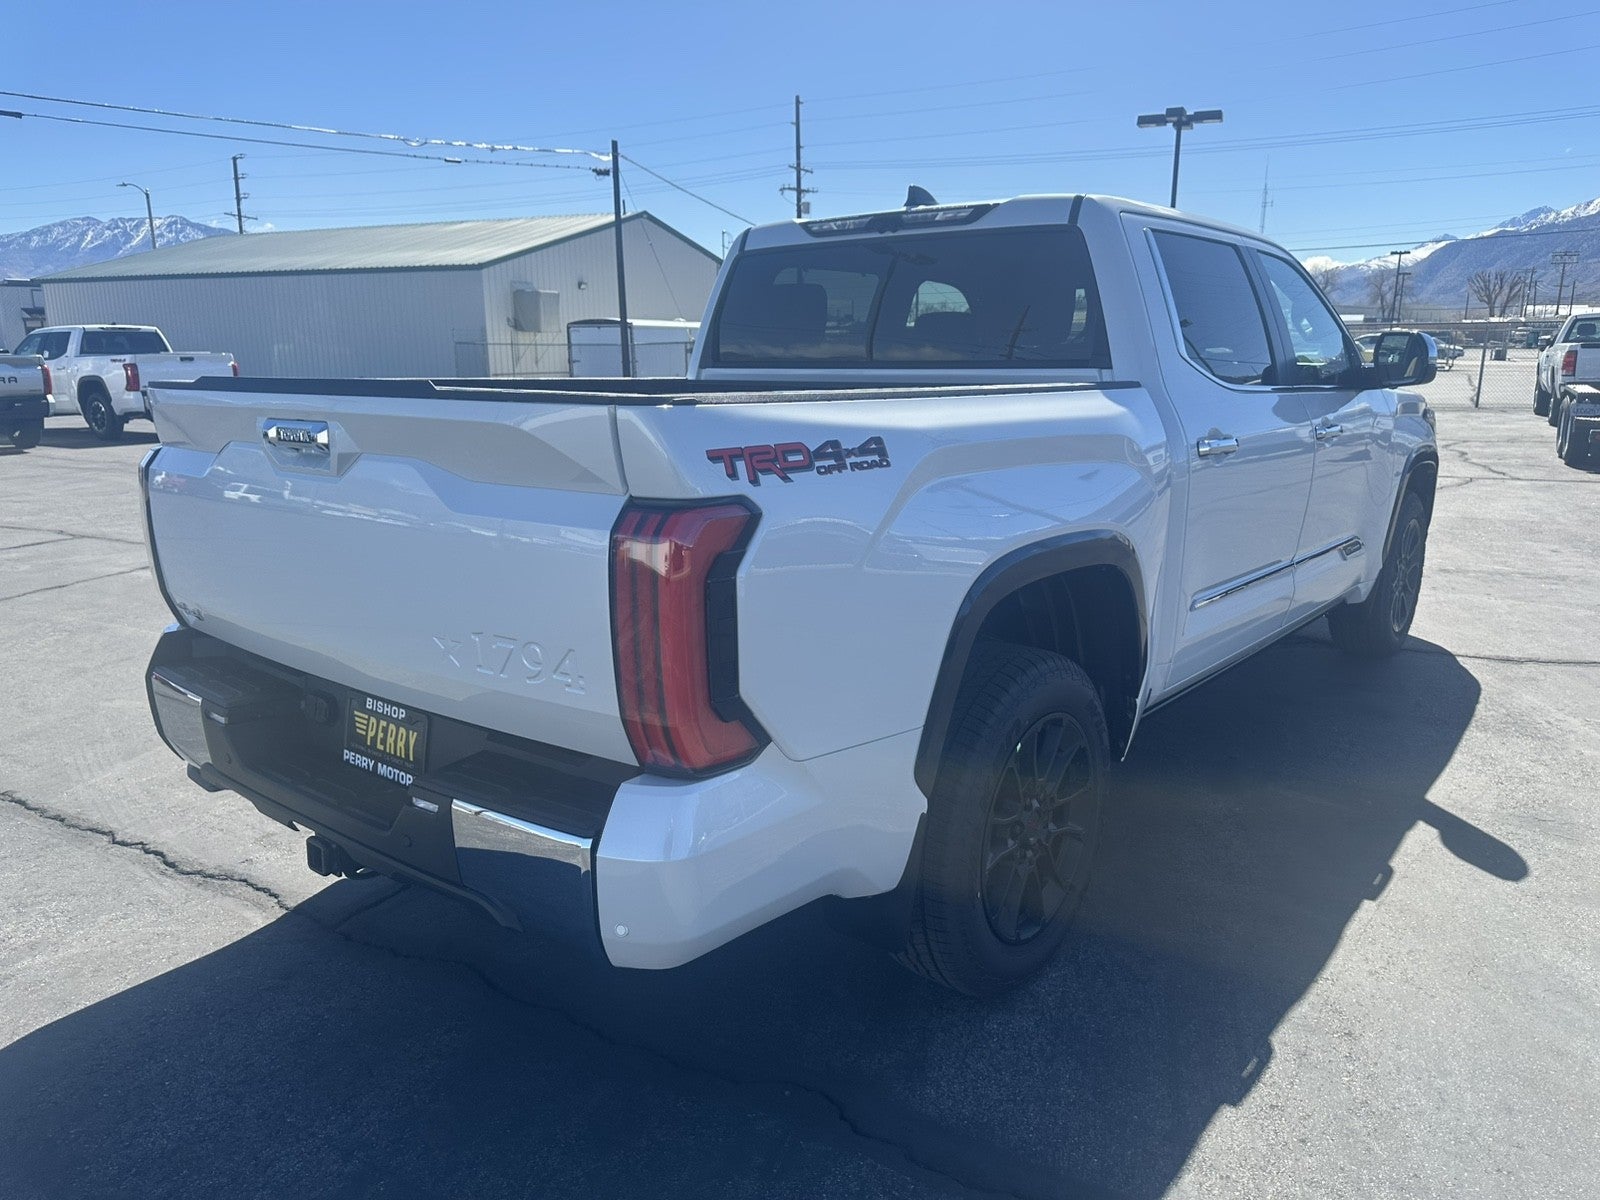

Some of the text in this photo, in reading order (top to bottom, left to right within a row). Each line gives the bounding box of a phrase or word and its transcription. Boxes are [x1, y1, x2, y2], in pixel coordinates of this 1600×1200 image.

[706, 441, 815, 487] TRD
[816, 458, 891, 476] OFF ROAD
[471, 631, 586, 695] 1794
[366, 697, 406, 720] BISHOP
[367, 716, 418, 761] PERRY
[343, 748, 375, 772] PERRY
